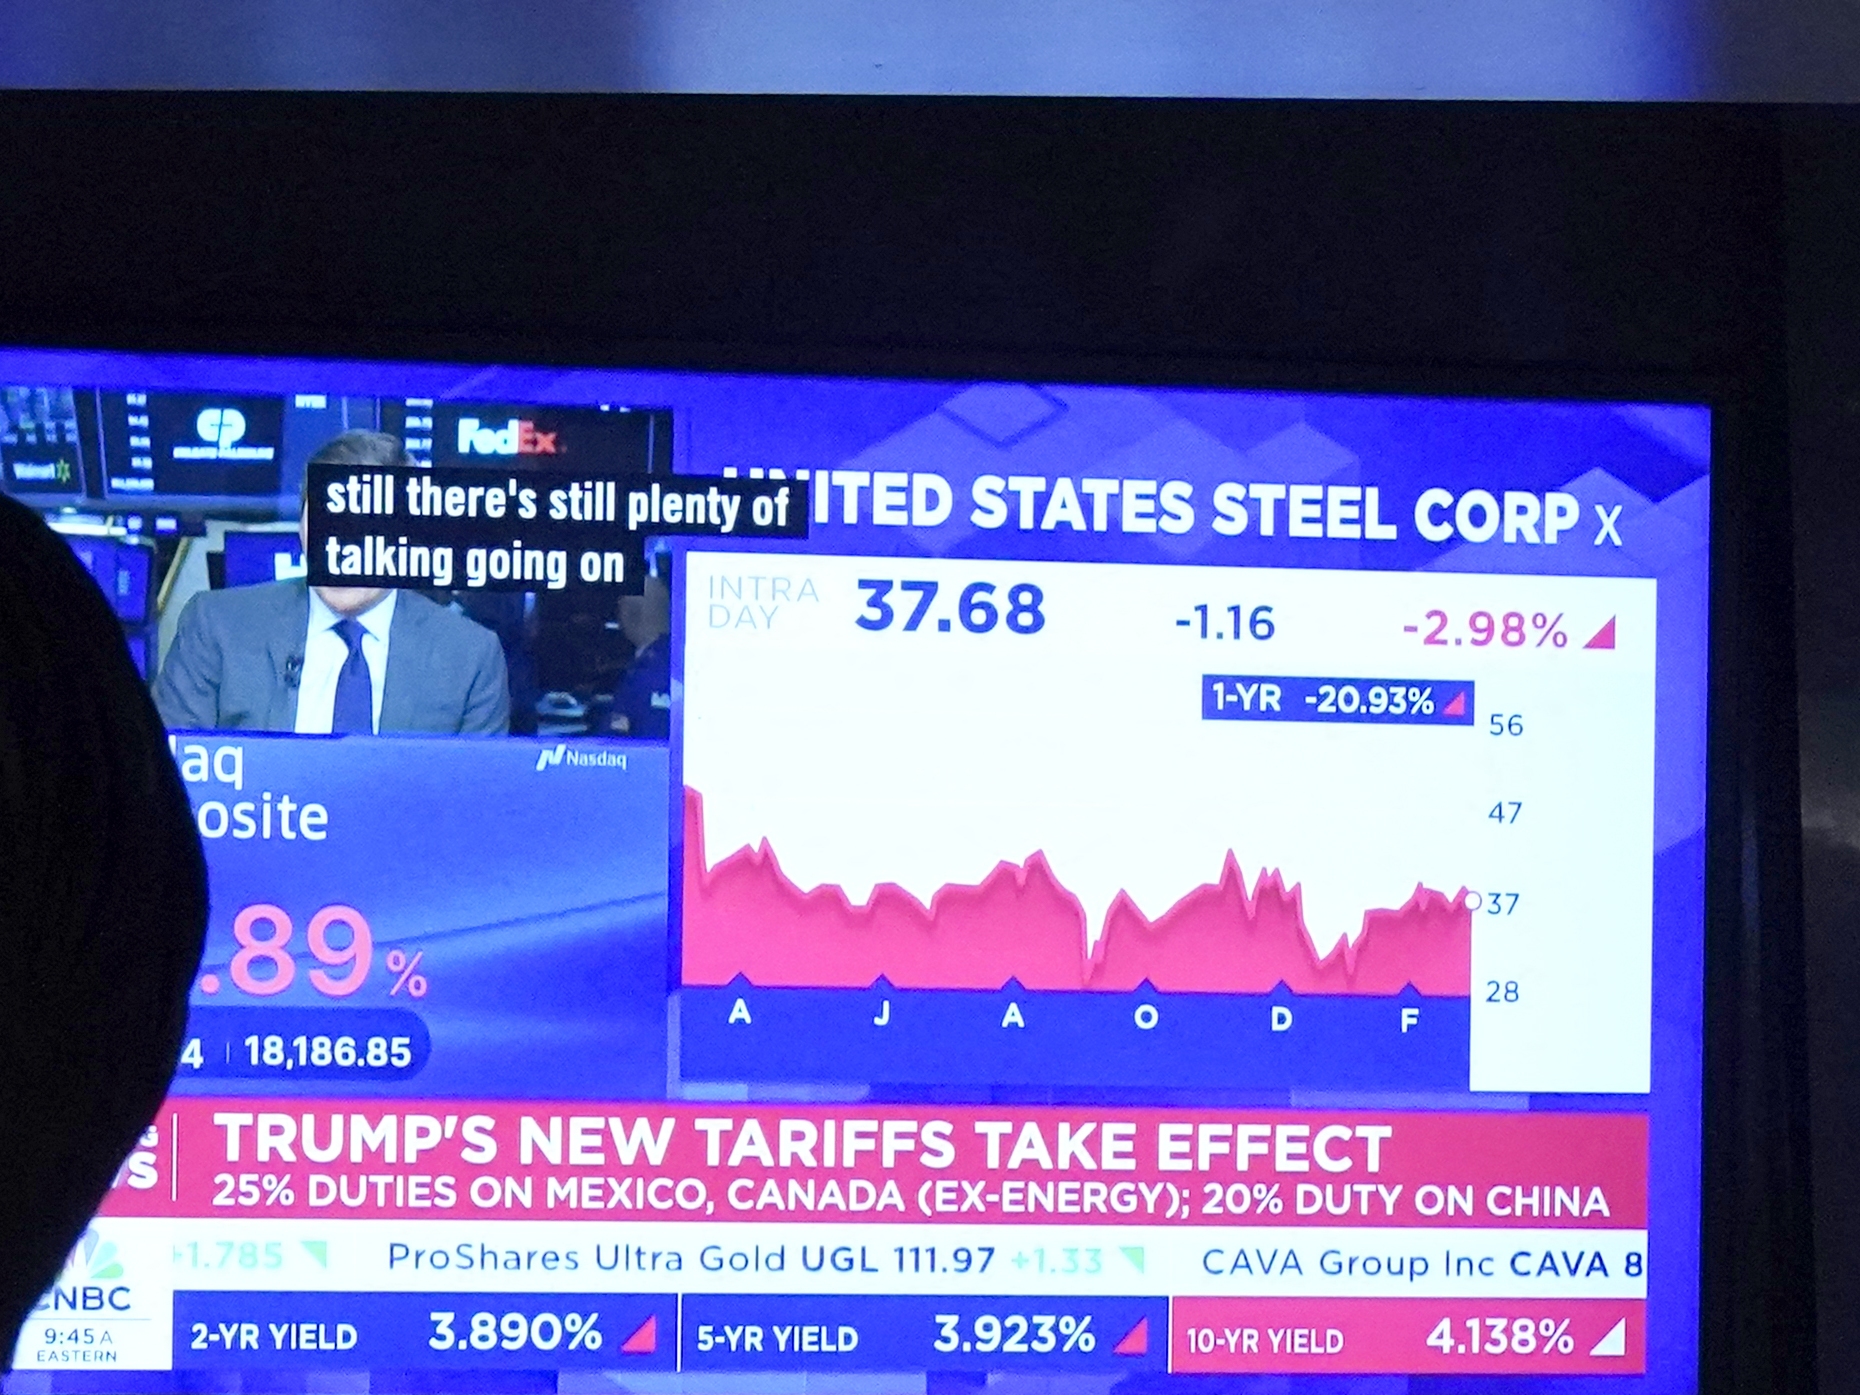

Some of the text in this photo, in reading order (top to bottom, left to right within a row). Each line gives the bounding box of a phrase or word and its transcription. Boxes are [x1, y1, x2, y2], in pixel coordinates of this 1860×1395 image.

[458, 418, 558, 454] FedEx
[326, 474, 790, 532] still there's still plenty of
[723, 467, 953, 527] ITED
[971, 474, 1195, 534] STATES
[1212, 482, 1398, 541] STEEL
[1414, 487, 1580, 545] CORP
[326, 536, 624, 589] talking going on
[708, 575, 819, 602] INTRA
[855, 578, 1046, 634] 37.68
[708, 604, 779, 629] DAY
[1176, 604, 1276, 641] -1.16
[1403, 609, 1568, 648] -2.98%
[1212, 682, 1436, 715] 1-YR -20.93%
[1490, 714, 1524, 736] 56
[168, 735, 244, 790] aq
[566, 749, 627, 771] Nasdaq
[1488, 801, 1523, 824] 47
[1487, 893, 1520, 915] 37
[1485, 980, 1519, 1003] 28
[728, 998, 1420, 1033] A J A O D F
[244, 1034, 412, 1071] 18,186.85
[213, 1112, 498, 1164] TRUMP'S
[519, 1116, 676, 1166] NEW
[694, 1118, 956, 1169] TARIFFS
[974, 1121, 1137, 1170] TAKE
[1158, 1123, 1393, 1173] EFFECT
[212, 1173, 1611, 1219] 25% DUTIES ON MEXICO, CANADA (EX-ENERGY); 20% DUTY ON CHINA
[389, 1242, 579, 1271] ProShares
[596, 1244, 683, 1272] Ultra
[699, 1244, 786, 1273] Gold
[802, 1245, 879, 1273] UGL
[893, 1246, 996, 1274] 111.97
[1011, 1246, 1103, 1274] +1.33
[1202, 1248, 1304, 1276] CAVA
[1319, 1249, 1430, 1283] Group
[1445, 1249, 1495, 1277] Inc
[1510, 1250, 1609, 1278] CAVA
[1624, 1251, 1643, 1278] 8
[190, 1312, 603, 1351] 2-YR YIELD 3.890%
[697, 1314, 1097, 1353] 5-YR YIELD 3.923%
[1186, 1316, 1575, 1355] 10-YR YIELD 4.138%
[36, 1349, 118, 1363] EASTERN
